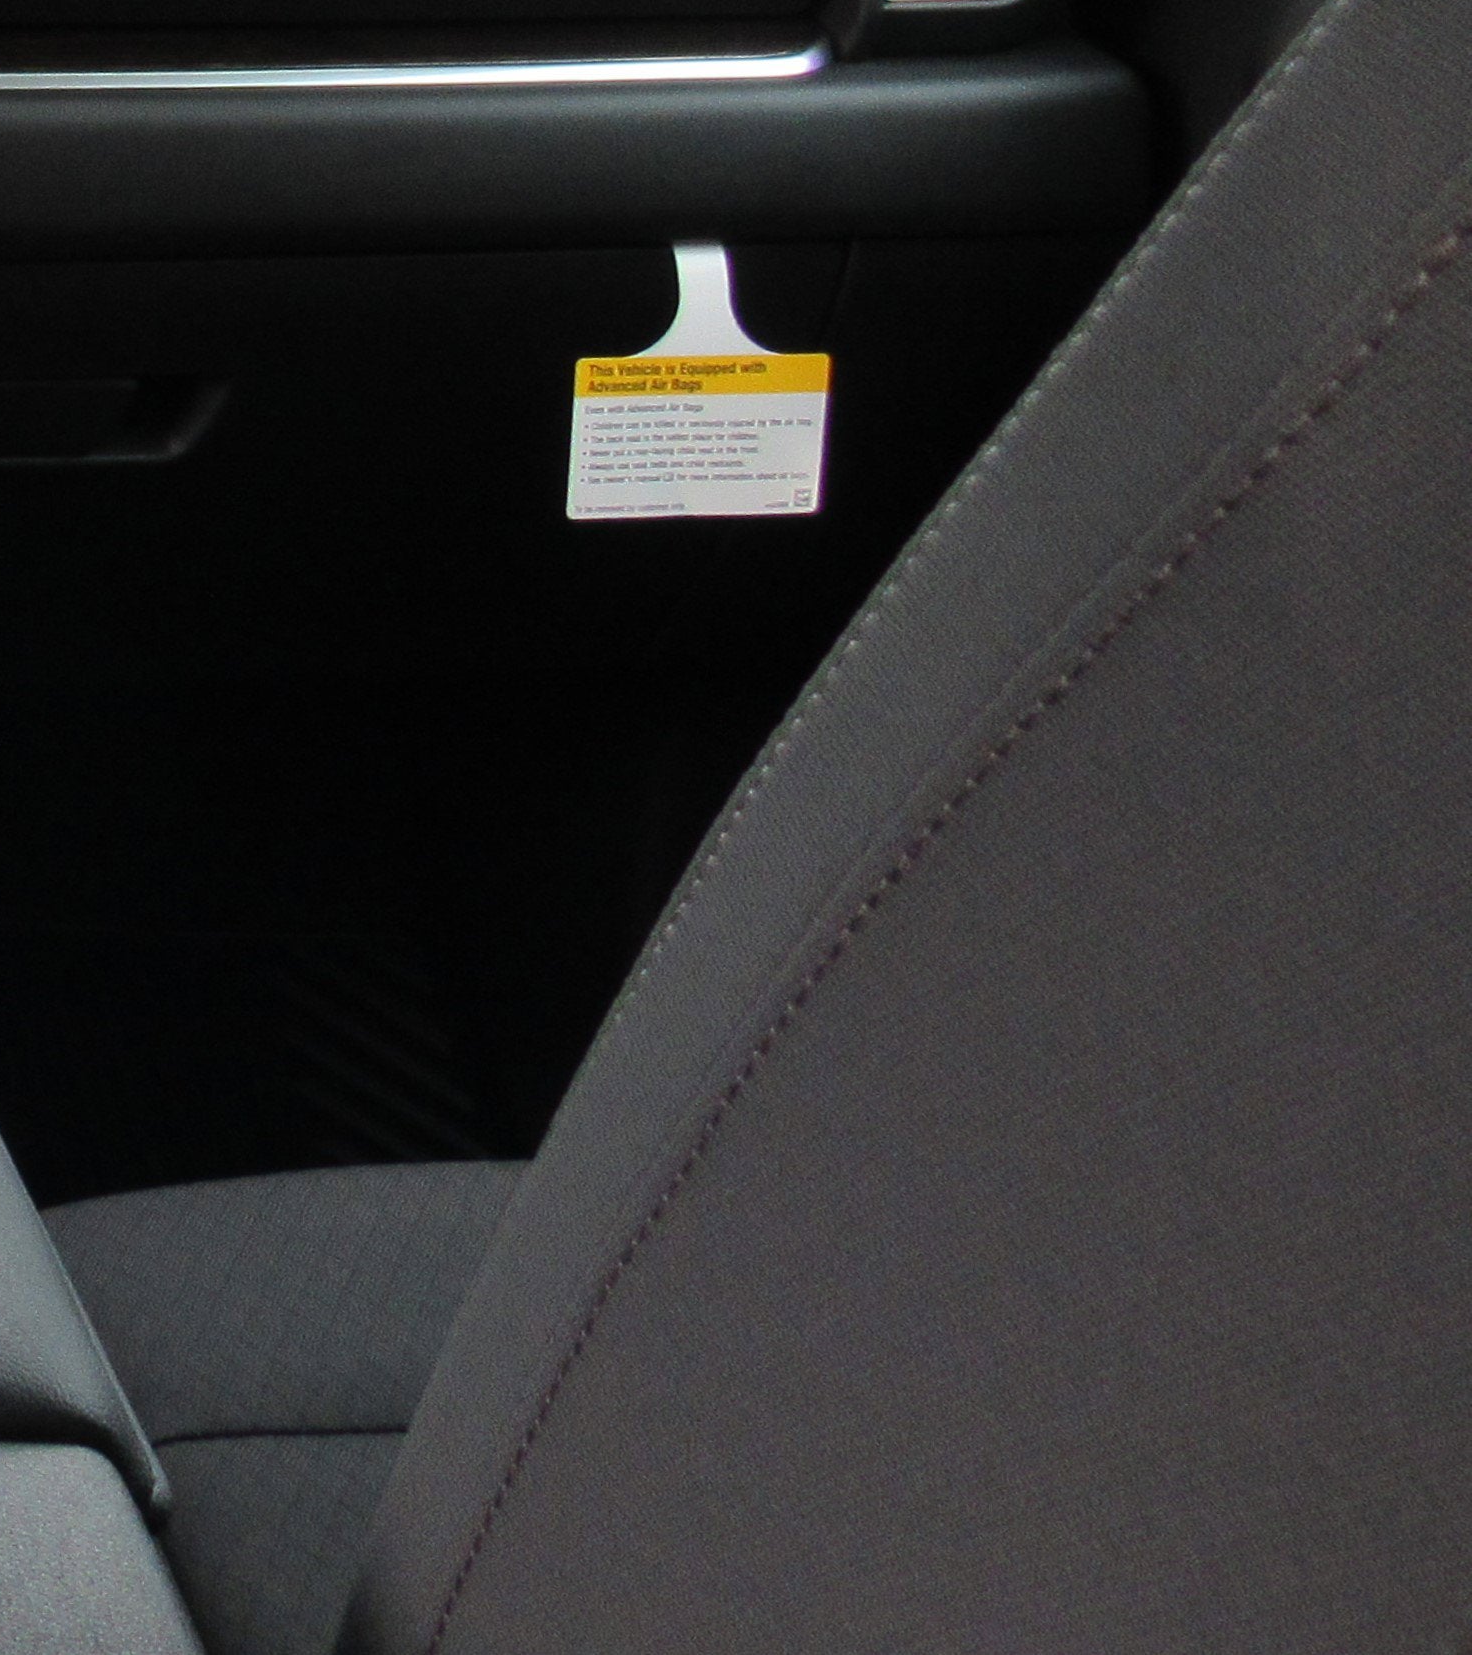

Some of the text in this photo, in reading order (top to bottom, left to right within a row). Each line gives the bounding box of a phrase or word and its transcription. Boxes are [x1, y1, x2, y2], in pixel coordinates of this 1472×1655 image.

[589, 364, 614, 376] This
[587, 378, 703, 394] Advanced Air Bags
